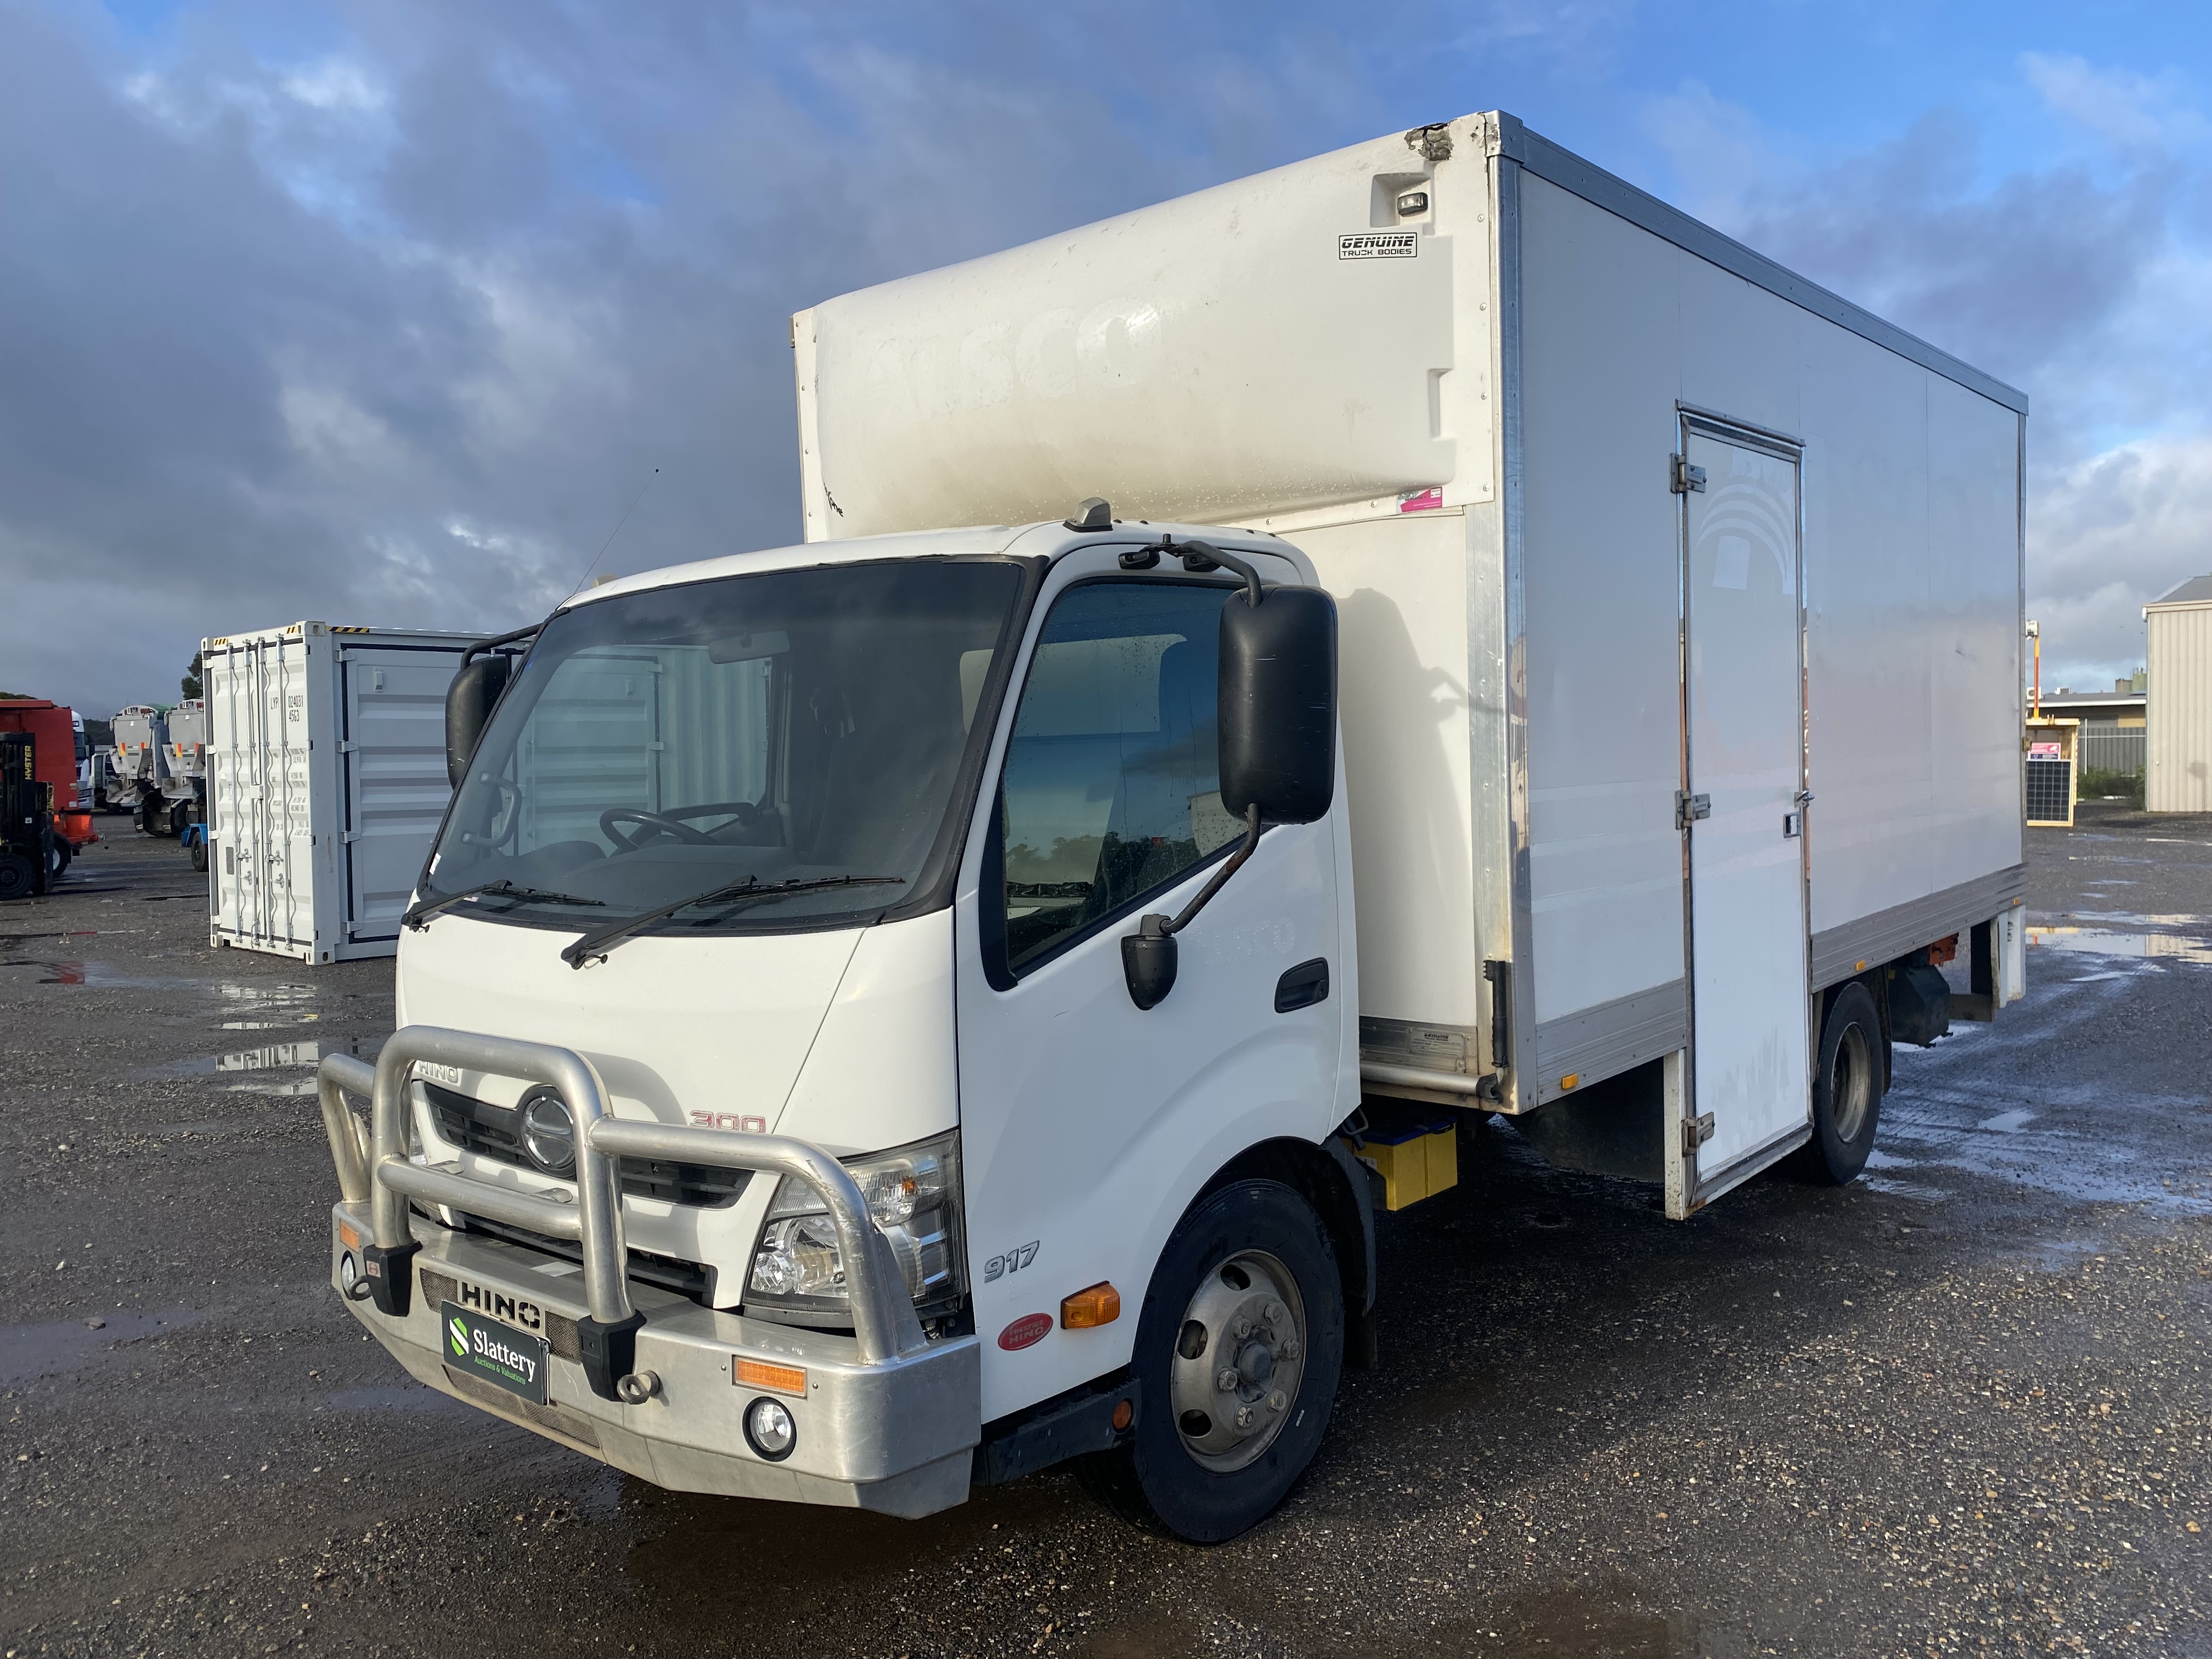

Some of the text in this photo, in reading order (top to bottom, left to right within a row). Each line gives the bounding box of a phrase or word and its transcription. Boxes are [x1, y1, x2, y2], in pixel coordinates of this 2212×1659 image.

[1341, 235, 1414, 249] GENUINE
[288, 695, 303, 708] 024031
[419, 1060, 459, 1084] HINO
[690, 1110, 766, 1133] 300
[984, 1240, 1040, 1284] 917
[461, 1281, 540, 1329] HINO
[1009, 1319, 1044, 1336] PRESTIGE
[1009, 1326, 1044, 1345] HINO
[473, 1328, 536, 1383] Slattery
[473, 1355, 526, 1386] Auctions & Valuations
